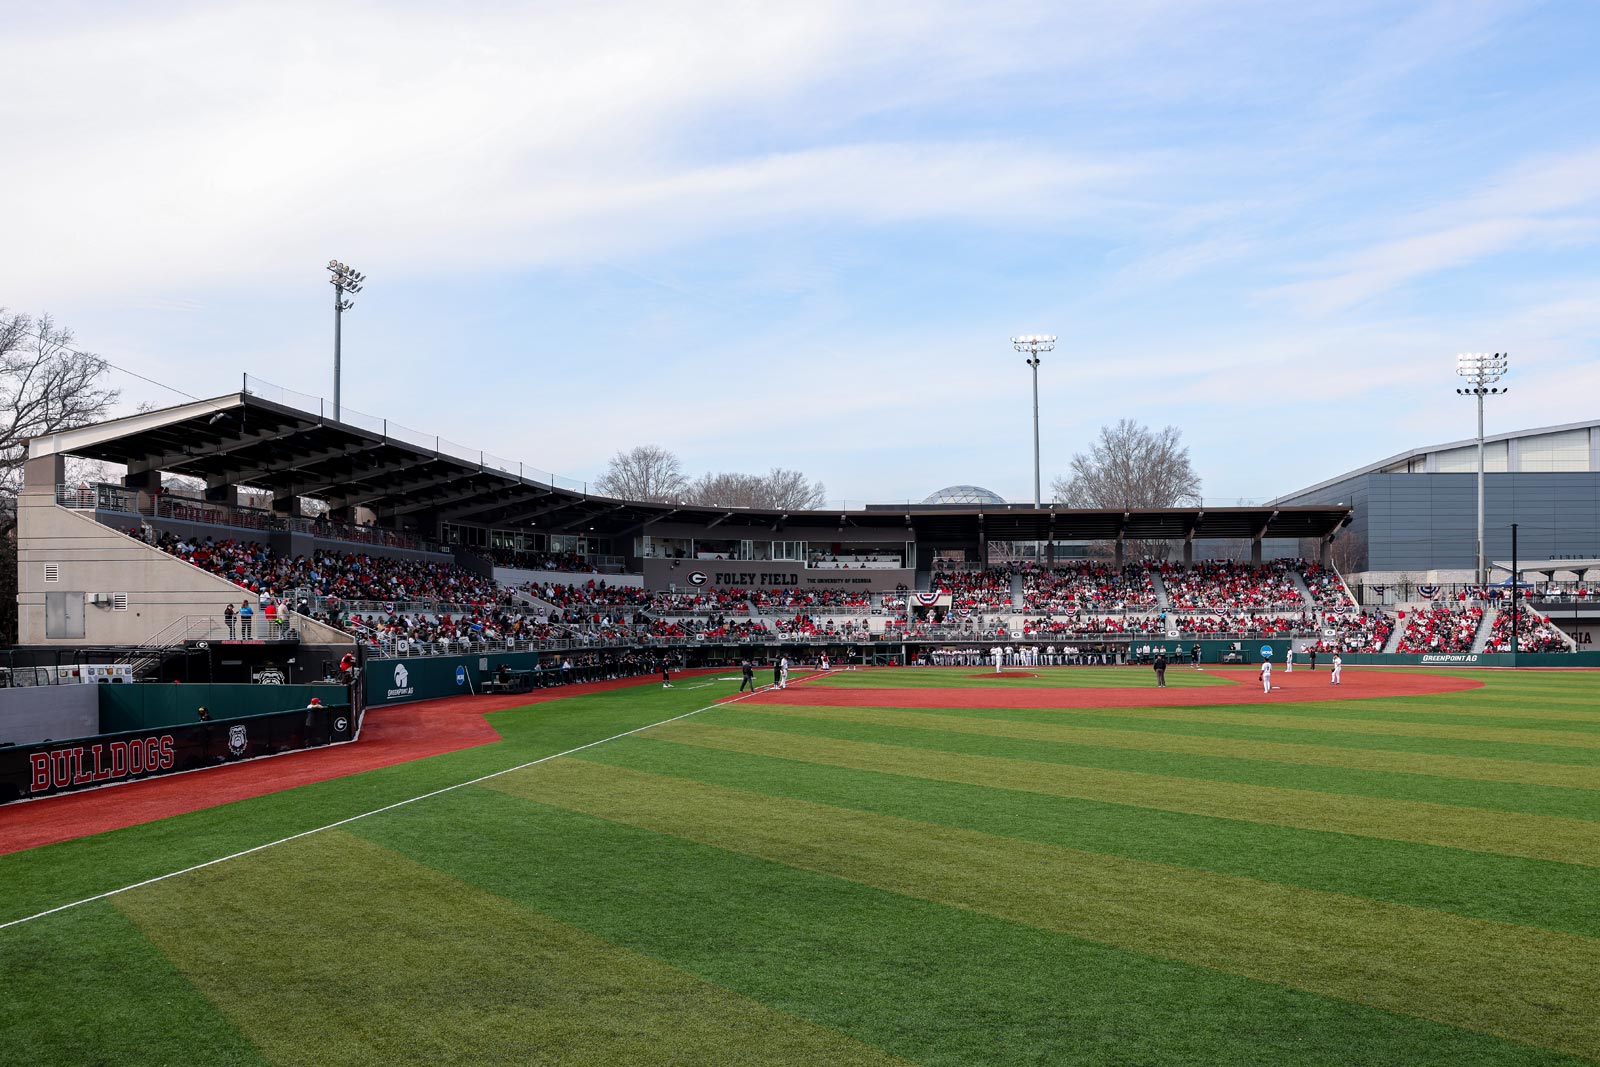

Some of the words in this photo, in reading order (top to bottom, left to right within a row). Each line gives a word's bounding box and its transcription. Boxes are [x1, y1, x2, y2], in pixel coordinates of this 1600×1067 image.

[690, 572, 708, 585] G
[715, 573, 756, 584] FOLEY
[761, 574, 798, 585] FIELD
[30, 735, 174, 792] BULLDOGS
